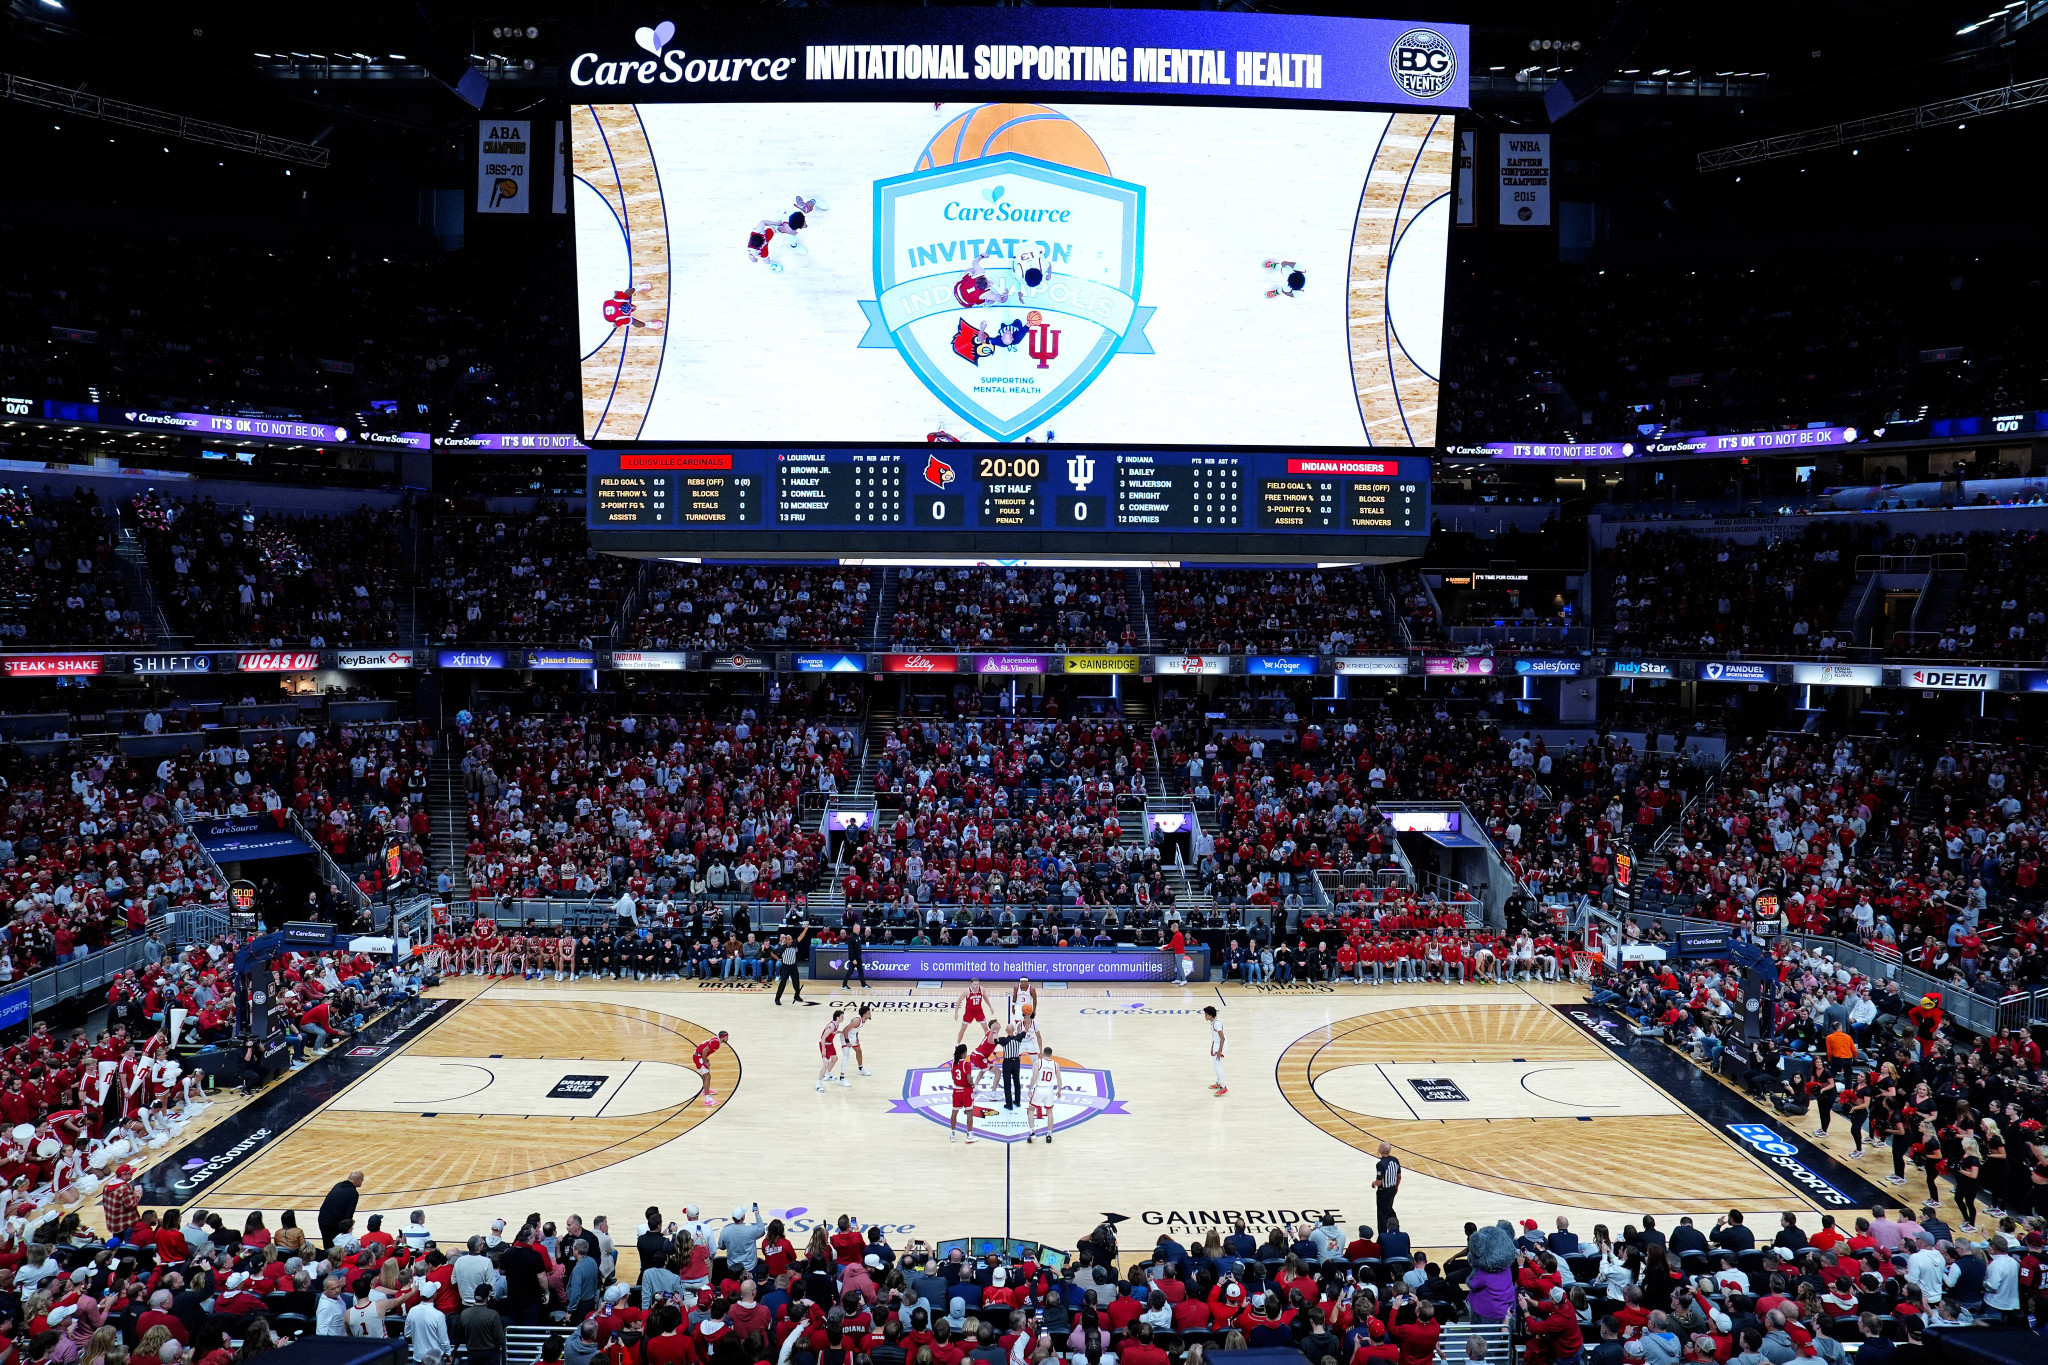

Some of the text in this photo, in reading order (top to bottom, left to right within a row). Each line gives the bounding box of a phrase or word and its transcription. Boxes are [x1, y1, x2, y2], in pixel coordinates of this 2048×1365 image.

[570, 44, 1322, 89] CareSource INVITATIONAL SUPPORTING MENTAL HEALTH
[1398, 47, 1451, 75] BDG
[1403, 76, 1443, 92] EVENTS
[488, 127, 520, 139] ABA
[1509, 141, 1541, 152] WNBA
[486, 164, 523, 176] 1969-70
[1514, 192, 1536, 201] 2015
[943, 201, 1071, 223] CareSource
[981, 376, 1034, 385] SUPPORTING
[973, 386, 1041, 394] MENTAL HEALTH
[6, 404, 29, 415] 0/0
[138, 413, 325, 438] CareSource IT'S OK TO NOT BE OK
[1996, 421, 2018, 432] 0/0
[1657, 431, 1832, 453] CareSource IT'S OK TO NOT BE OK
[1456, 445, 1613, 457] CareSource IT'S OK TO NOT BE OK
[629, 458, 723, 466] LOUISVILLE CARDINALS
[980, 458, 1040, 477] 20:00
[1302, 462, 1384, 472] INDIANA HOOSIERS
[706, 478, 724, 487] (OFF)
[1373, 484, 1390, 492] (OFF)
[692, 490, 719, 498] BLOCKS
[989, 485, 1031, 493] 1ST HALF
[932, 501, 945, 520] 0
[1074, 502, 1087, 520] 0
[1118, 515, 1127, 523] 12
[238, 654, 319, 669] LUCAS OIL
[339, 655, 386, 666] KeyBank
[453, 653, 492, 667] xfinity
[541, 657, 565, 665] planet
[614, 653, 642, 661] INDIANA
[4, 661, 46, 671] STEAK
[57, 660, 98, 670] SHAKE
[133, 657, 191, 671] SHIFT
[905, 656, 935, 671] Lilly
[1080, 660, 1135, 669] GAINBRIDGE
[1274, 659, 1300, 673] Kroger
[1533, 661, 1580, 672] salesforce
[1926, 672, 1987, 687] DEEM
[211, 825, 258, 834] CareSource
[237, 897, 251, 907] 30
[1758, 897, 1777, 905] 20:00
[1761, 905, 1774, 914] 30
[921, 959, 1163, 975] is committed to healthier, stronger communities
[3, 1001, 28, 1016] SPORTS
[1570, 1011, 1626, 1046] CareSource
[955, 1069, 962, 1080] 3
[1041, 1071, 1052, 1082] 10
[1726, 1124, 1798, 1157] BDG
[174, 1127, 272, 1189] CareSource
[1772, 1156, 1851, 1205] SPORTS
[1141, 1209, 1346, 1226] GAINBRIDGE
[360, 1322, 369, 1335] 1
